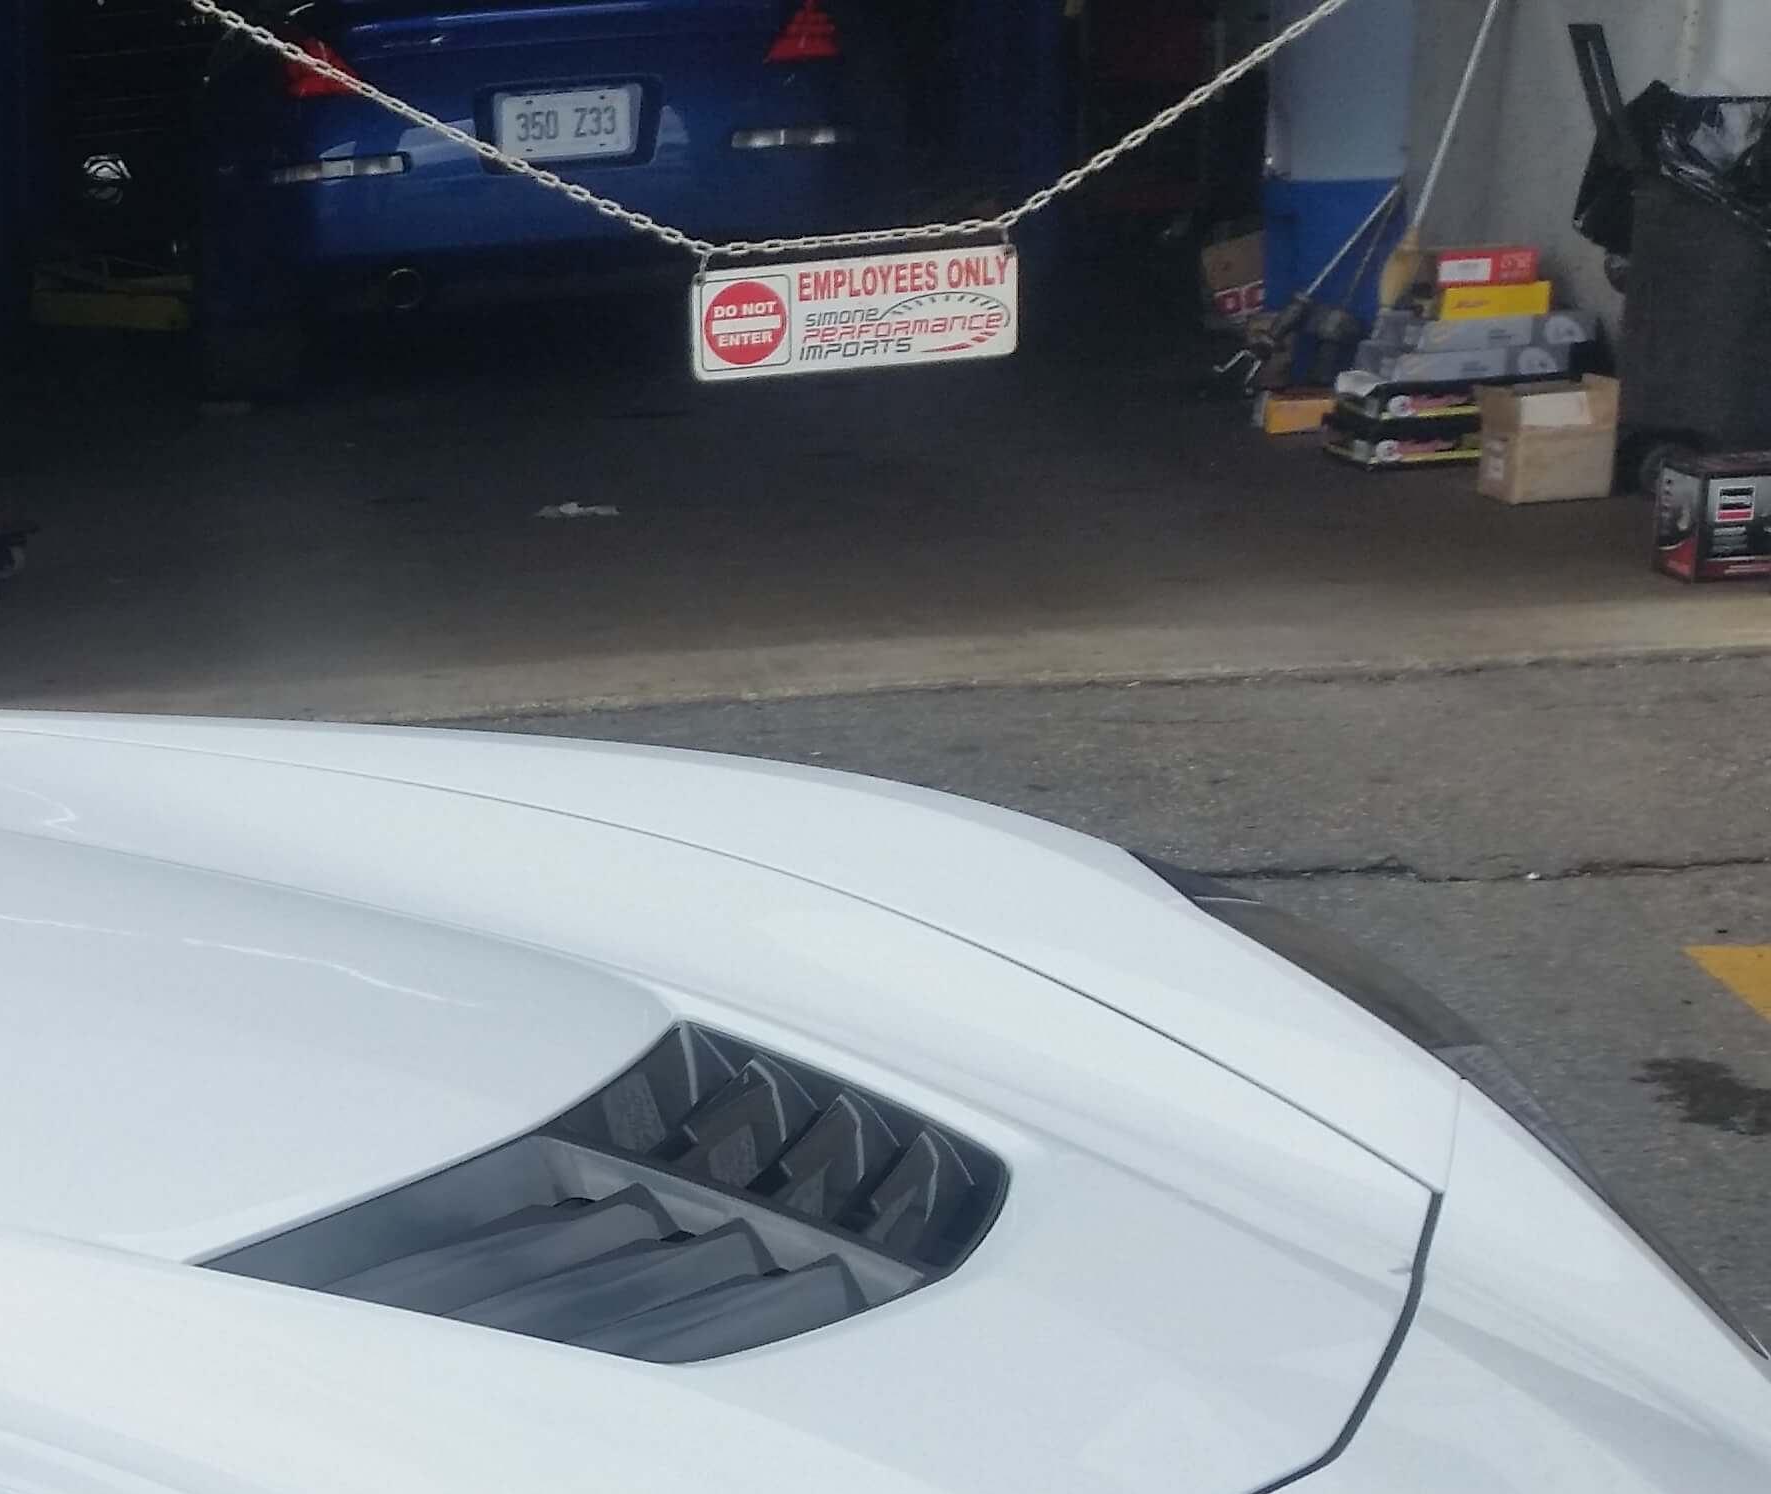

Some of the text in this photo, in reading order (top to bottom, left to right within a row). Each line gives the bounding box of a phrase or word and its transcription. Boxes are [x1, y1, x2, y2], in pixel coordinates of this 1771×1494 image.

[515, 105, 617, 142] 350 Z33
[797, 254, 1010, 301] EMPLOYEES ONLY
[713, 300, 777, 318] DO NOT
[717, 331, 774, 348] ENTER
[799, 336, 912, 361] IMPORTS
